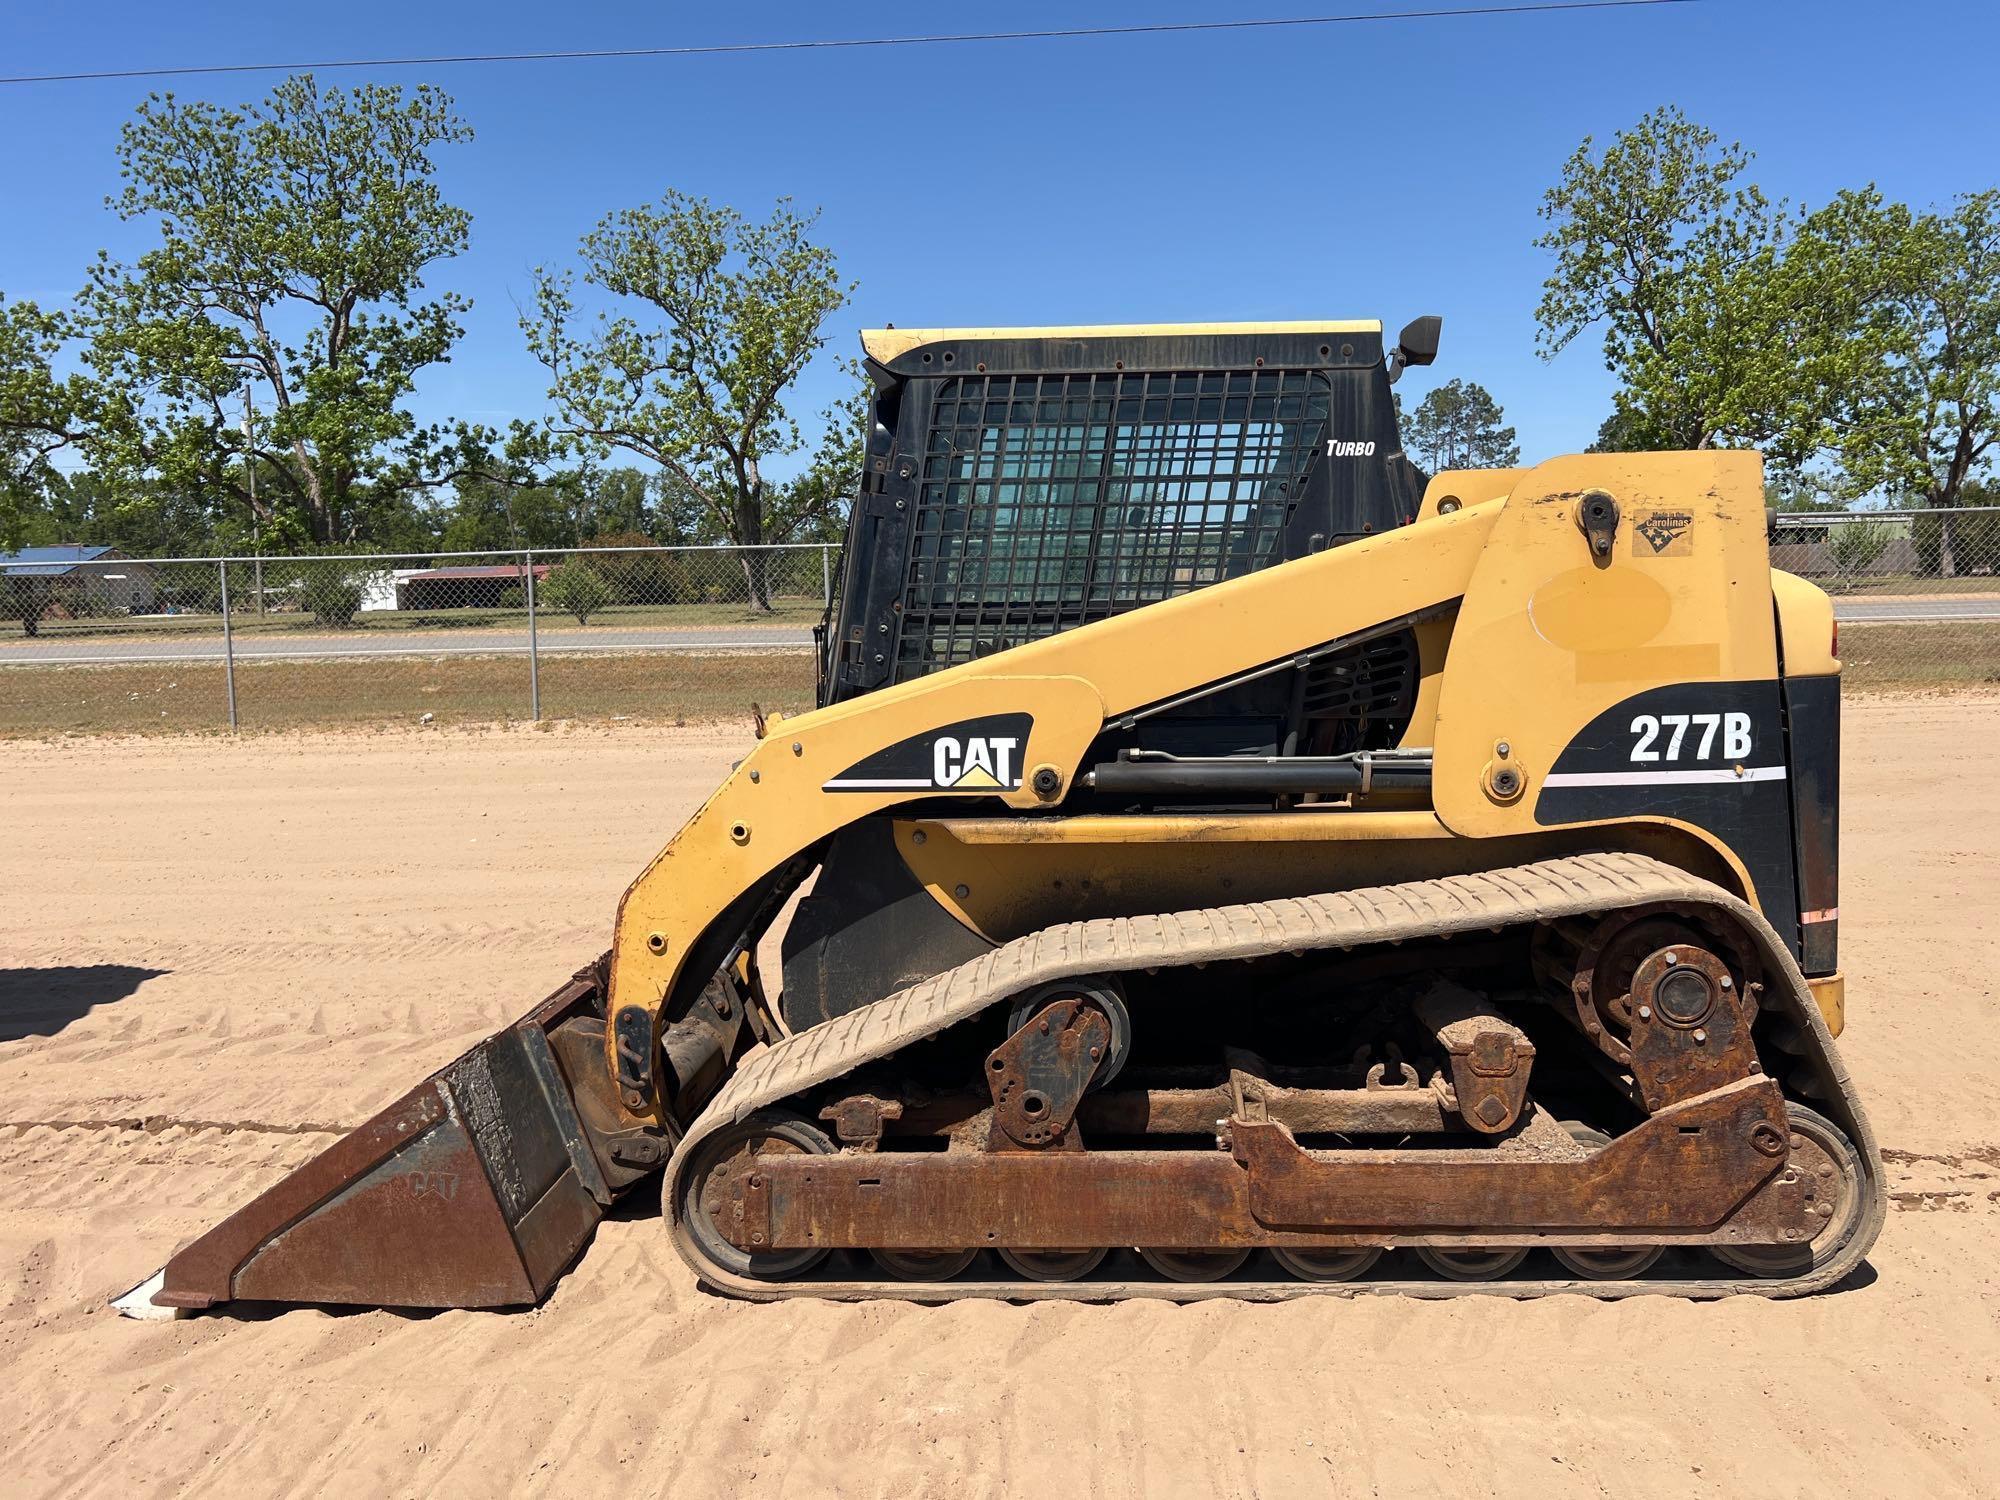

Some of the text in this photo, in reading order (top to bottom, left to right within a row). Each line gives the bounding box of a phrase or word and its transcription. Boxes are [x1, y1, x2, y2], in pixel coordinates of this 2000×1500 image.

[1646, 518, 1689, 527] Carolinas
[1629, 712, 1752, 762] 277B
[933, 736, 1017, 787] CAT
[408, 1170, 459, 1201] CAT
